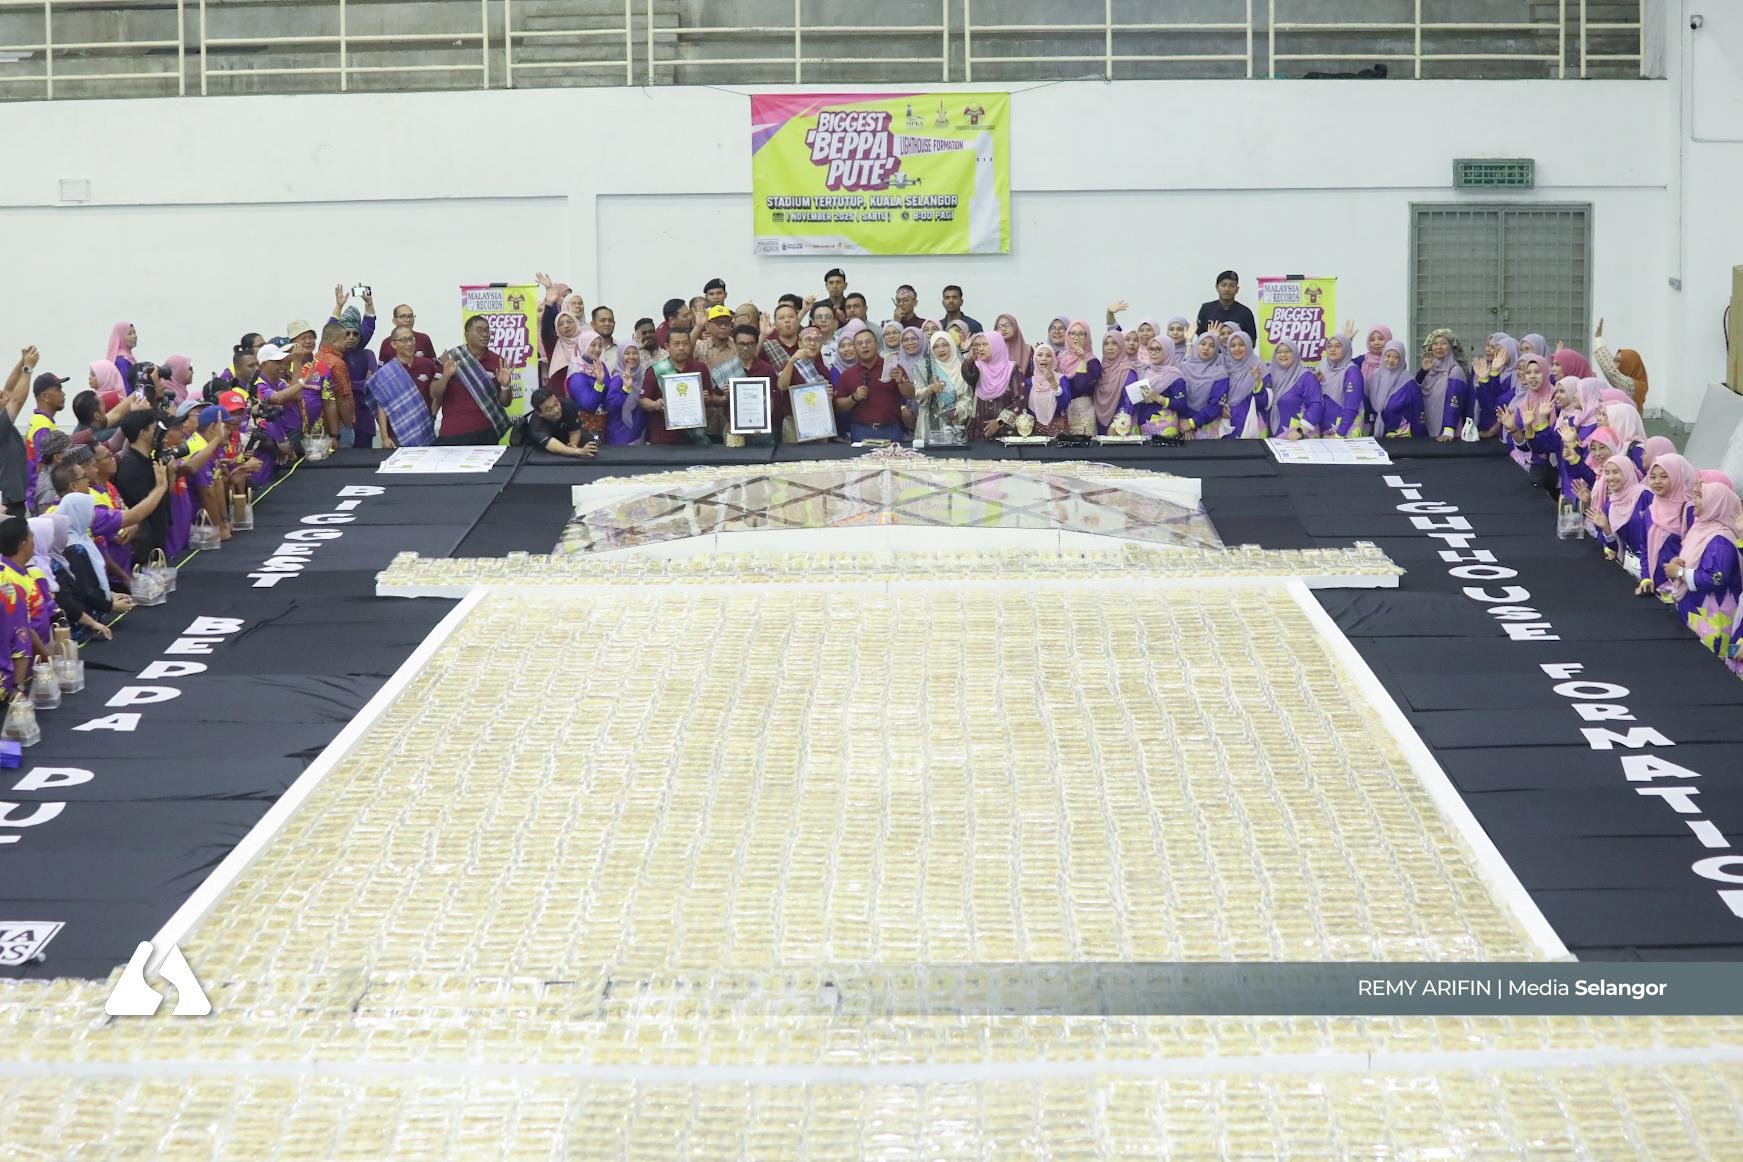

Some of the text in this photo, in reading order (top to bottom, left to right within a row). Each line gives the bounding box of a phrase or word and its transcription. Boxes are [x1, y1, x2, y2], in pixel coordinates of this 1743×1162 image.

[818, 112, 887, 132] BIGGEST
[806, 130, 889, 160] 'BEPPA
[933, 140, 964, 153] FORMATION
[827, 156, 896, 187] PUTE'
[766, 194, 959, 210] STADIUM TERTUTUP, KUALA SELANGOR
[791, 212, 832, 222] NOVEMBER
[834, 212, 855, 222] 2025
[935, 210, 954, 222] PAGI
[1264, 283, 1300, 292] MALAYSIA
[467, 291, 502, 300] MALAYSIA
[1272, 293, 1300, 303] RECORDS
[476, 300, 503, 310] RECORDS
[1273, 307, 1320, 321] BIGGEST
[1265, 320, 1322, 341] 'BEPPA
[246, 485, 387, 588] BIGGEST
[71, 616, 245, 732] BEPPA
[1382, 475, 1743, 919] LIGHTHOUSE FORMATIO
